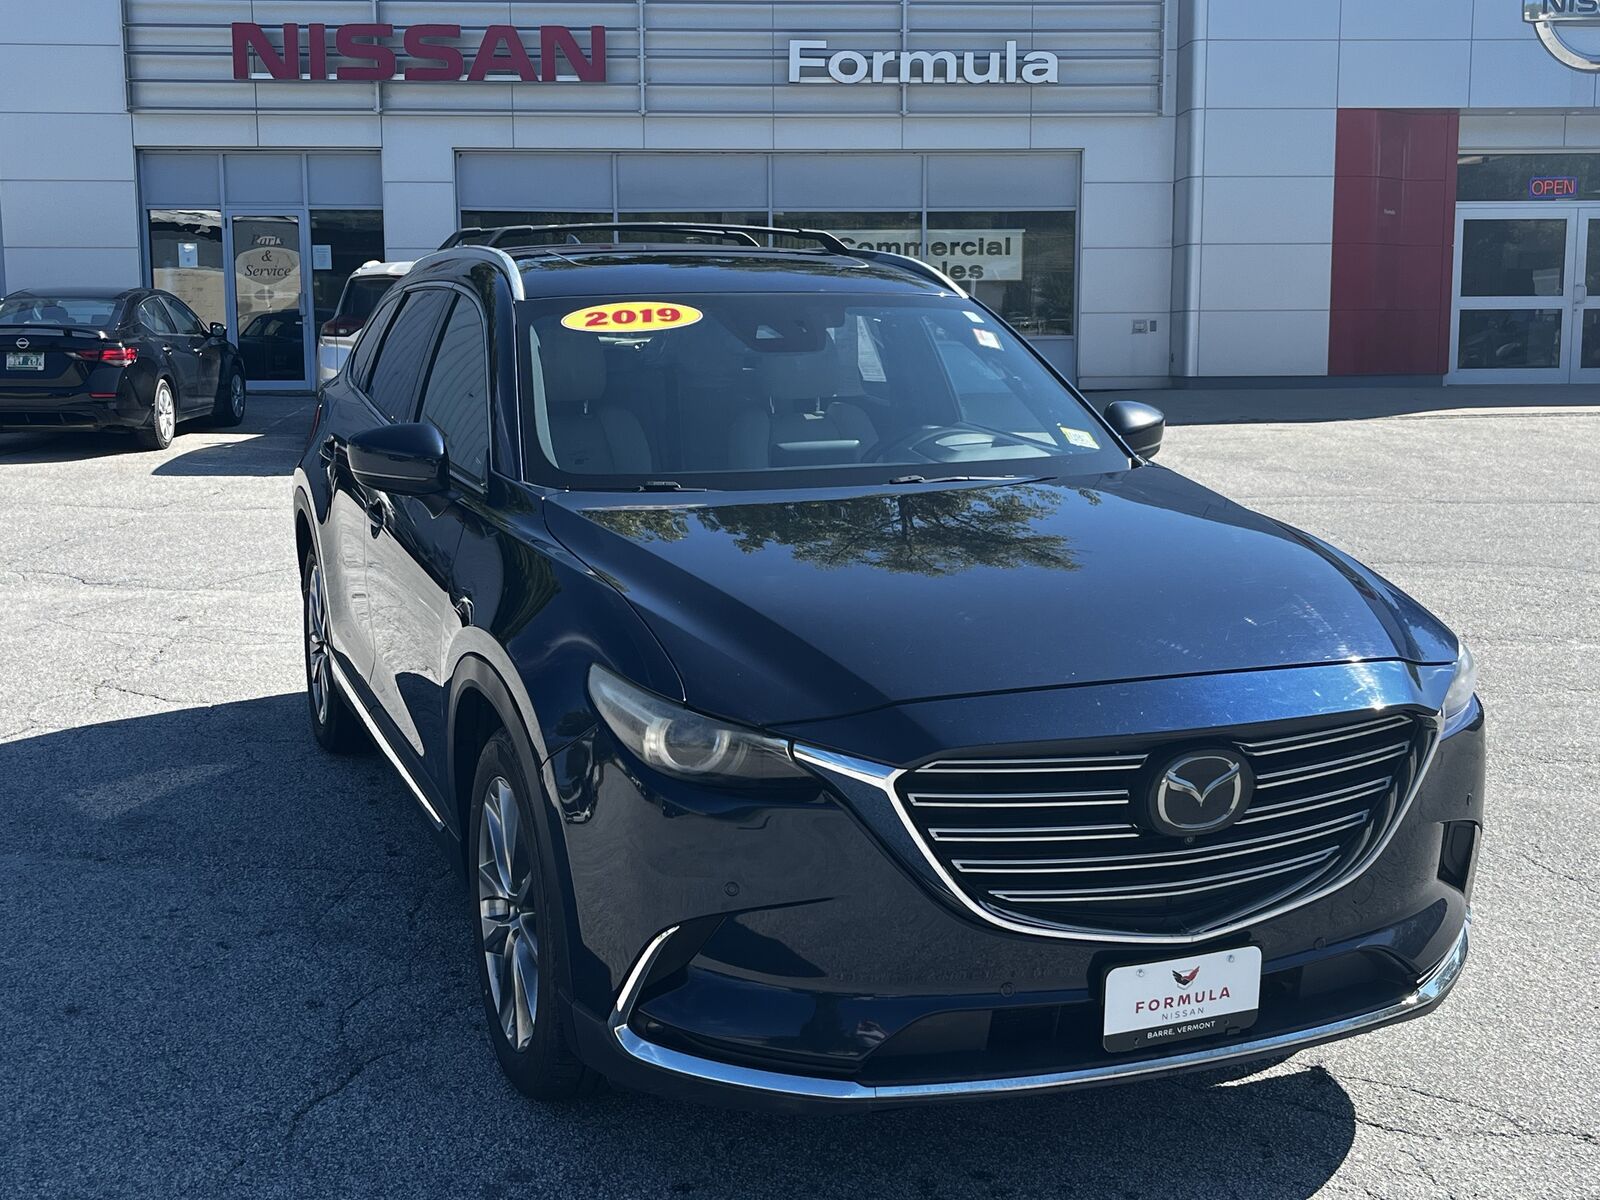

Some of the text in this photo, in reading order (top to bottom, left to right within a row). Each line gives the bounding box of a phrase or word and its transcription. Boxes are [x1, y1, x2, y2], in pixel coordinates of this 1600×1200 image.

[231, 22, 606, 82] NISSAN
[788, 39, 1059, 84] Formula
[1531, 179, 1575, 196] OPEN
[261, 249, 273, 262] &
[245, 264, 292, 277] Service
[584, 307, 682, 327] 2019
[1135, 986, 1231, 1014] FORMULA
[1161, 1006, 1205, 1021] NISSAN
[1147, 1020, 1216, 1040] BARRE, VERMONT
